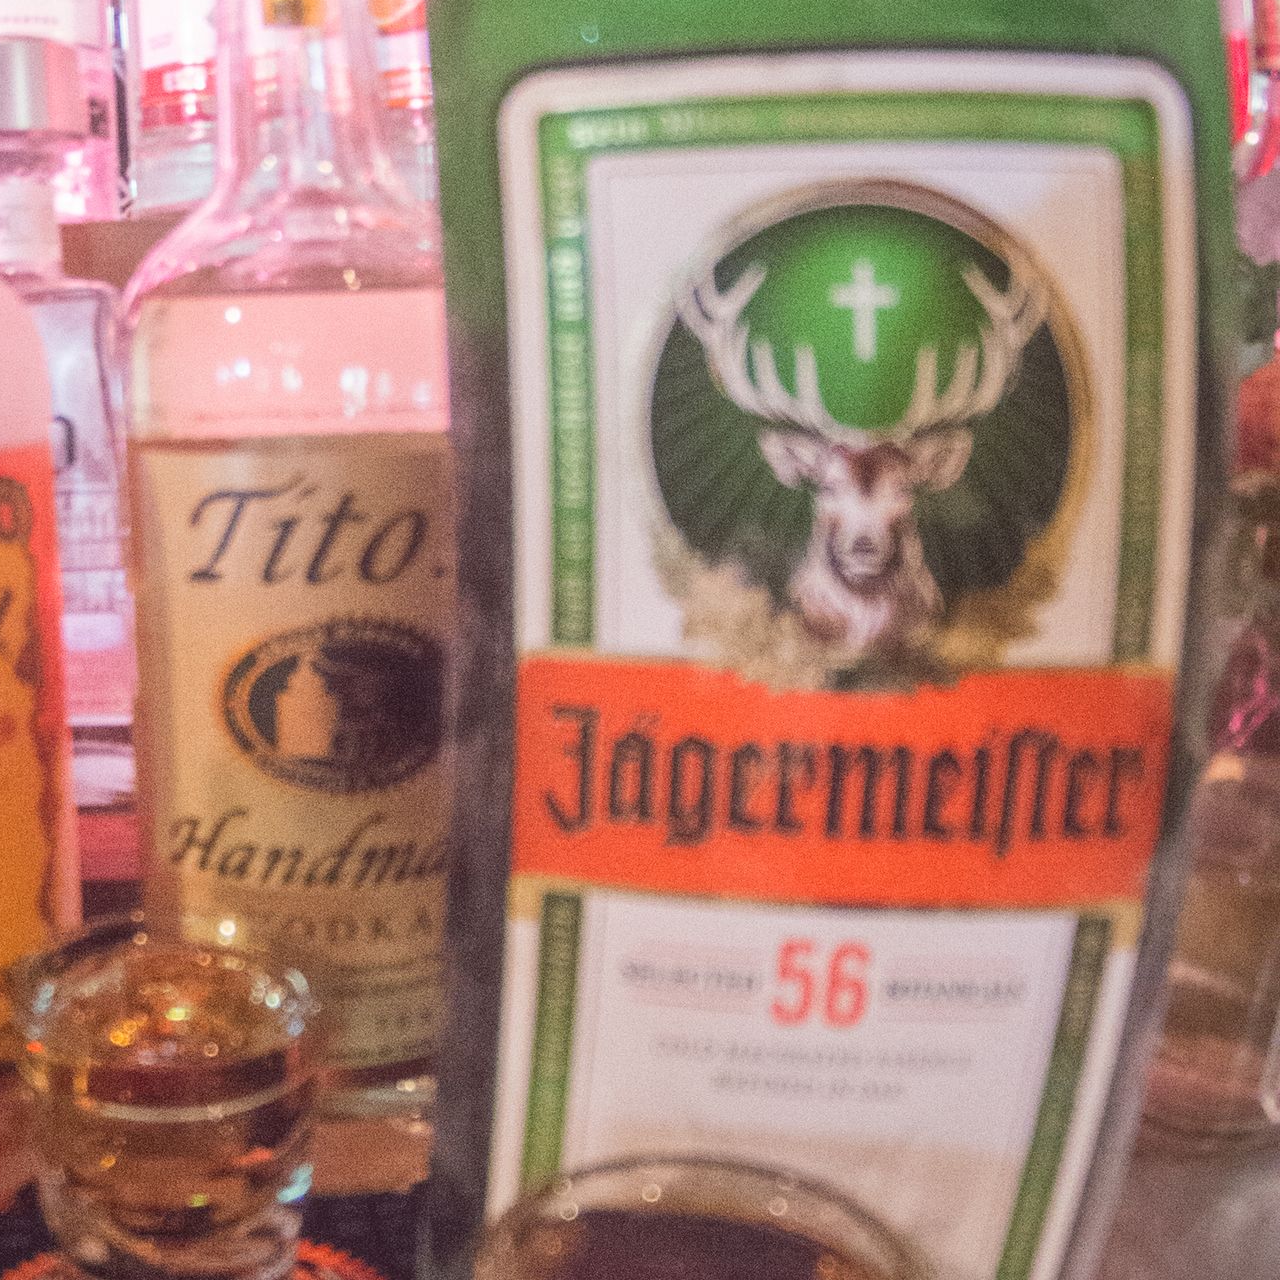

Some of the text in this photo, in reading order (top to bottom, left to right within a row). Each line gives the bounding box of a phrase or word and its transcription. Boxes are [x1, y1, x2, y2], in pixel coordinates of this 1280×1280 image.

[187, 472, 448, 586] Tito
[170, 806, 452, 892] Handma
[769, 935, 874, 1028] 56
